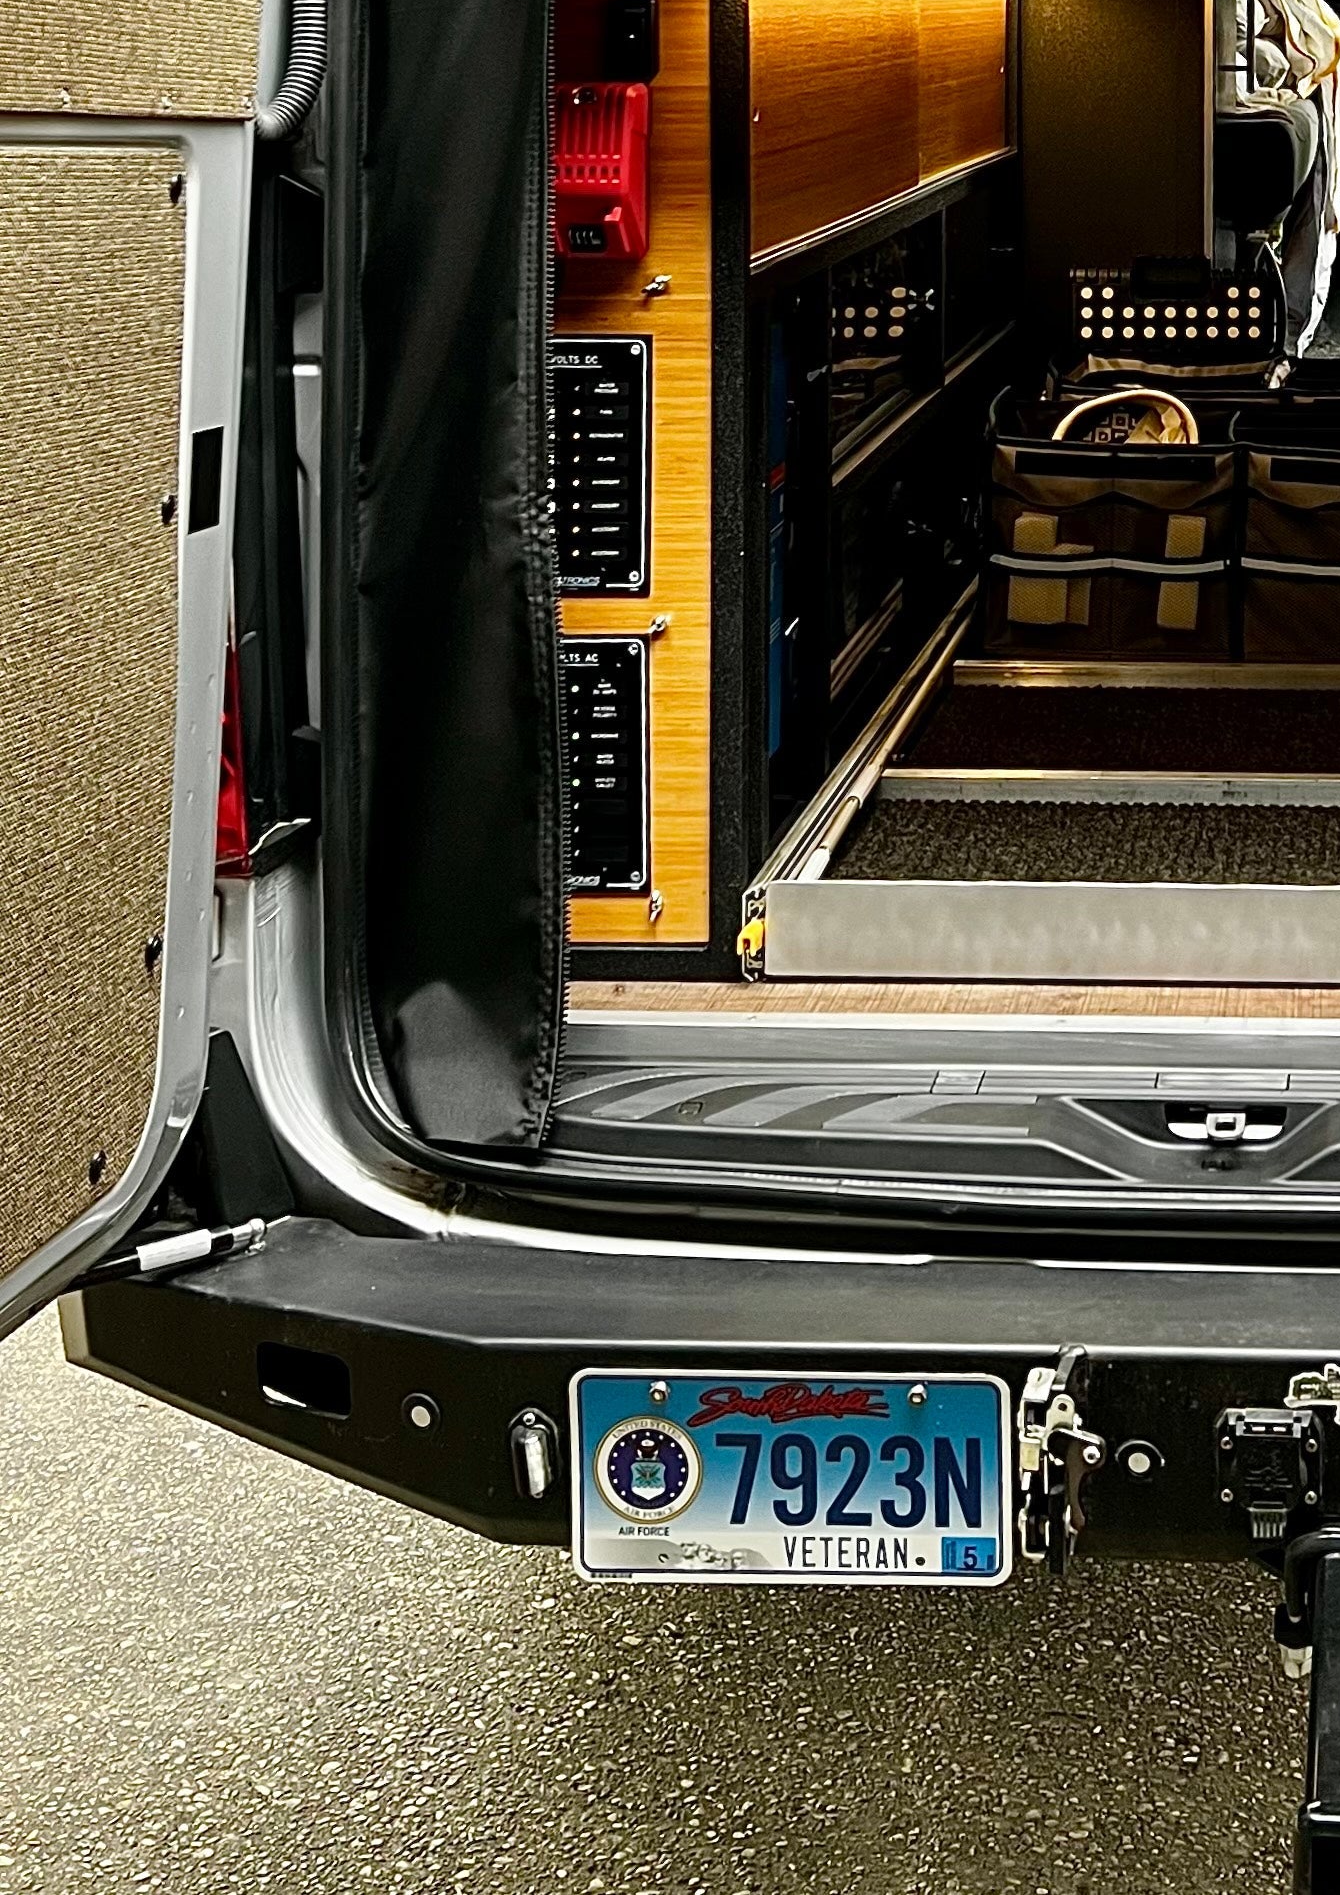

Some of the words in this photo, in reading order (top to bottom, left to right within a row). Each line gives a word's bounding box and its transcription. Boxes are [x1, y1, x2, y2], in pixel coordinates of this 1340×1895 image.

[585, 355, 598, 364] DC
[585, 653, 599, 663] AC
[612, 1420, 649, 1439] UNITED
[650, 1421, 682, 1440] STATES
[715, 1433, 982, 1529] 7923N
[624, 1506, 640, 1517] AIR
[643, 1506, 675, 1519] FORCE
[618, 1527, 635, 1536] AIR
[637, 1527, 670, 1537] FORCE
[783, 1536, 908, 1569] VETERAN
[962, 1545, 978, 1571] 5
